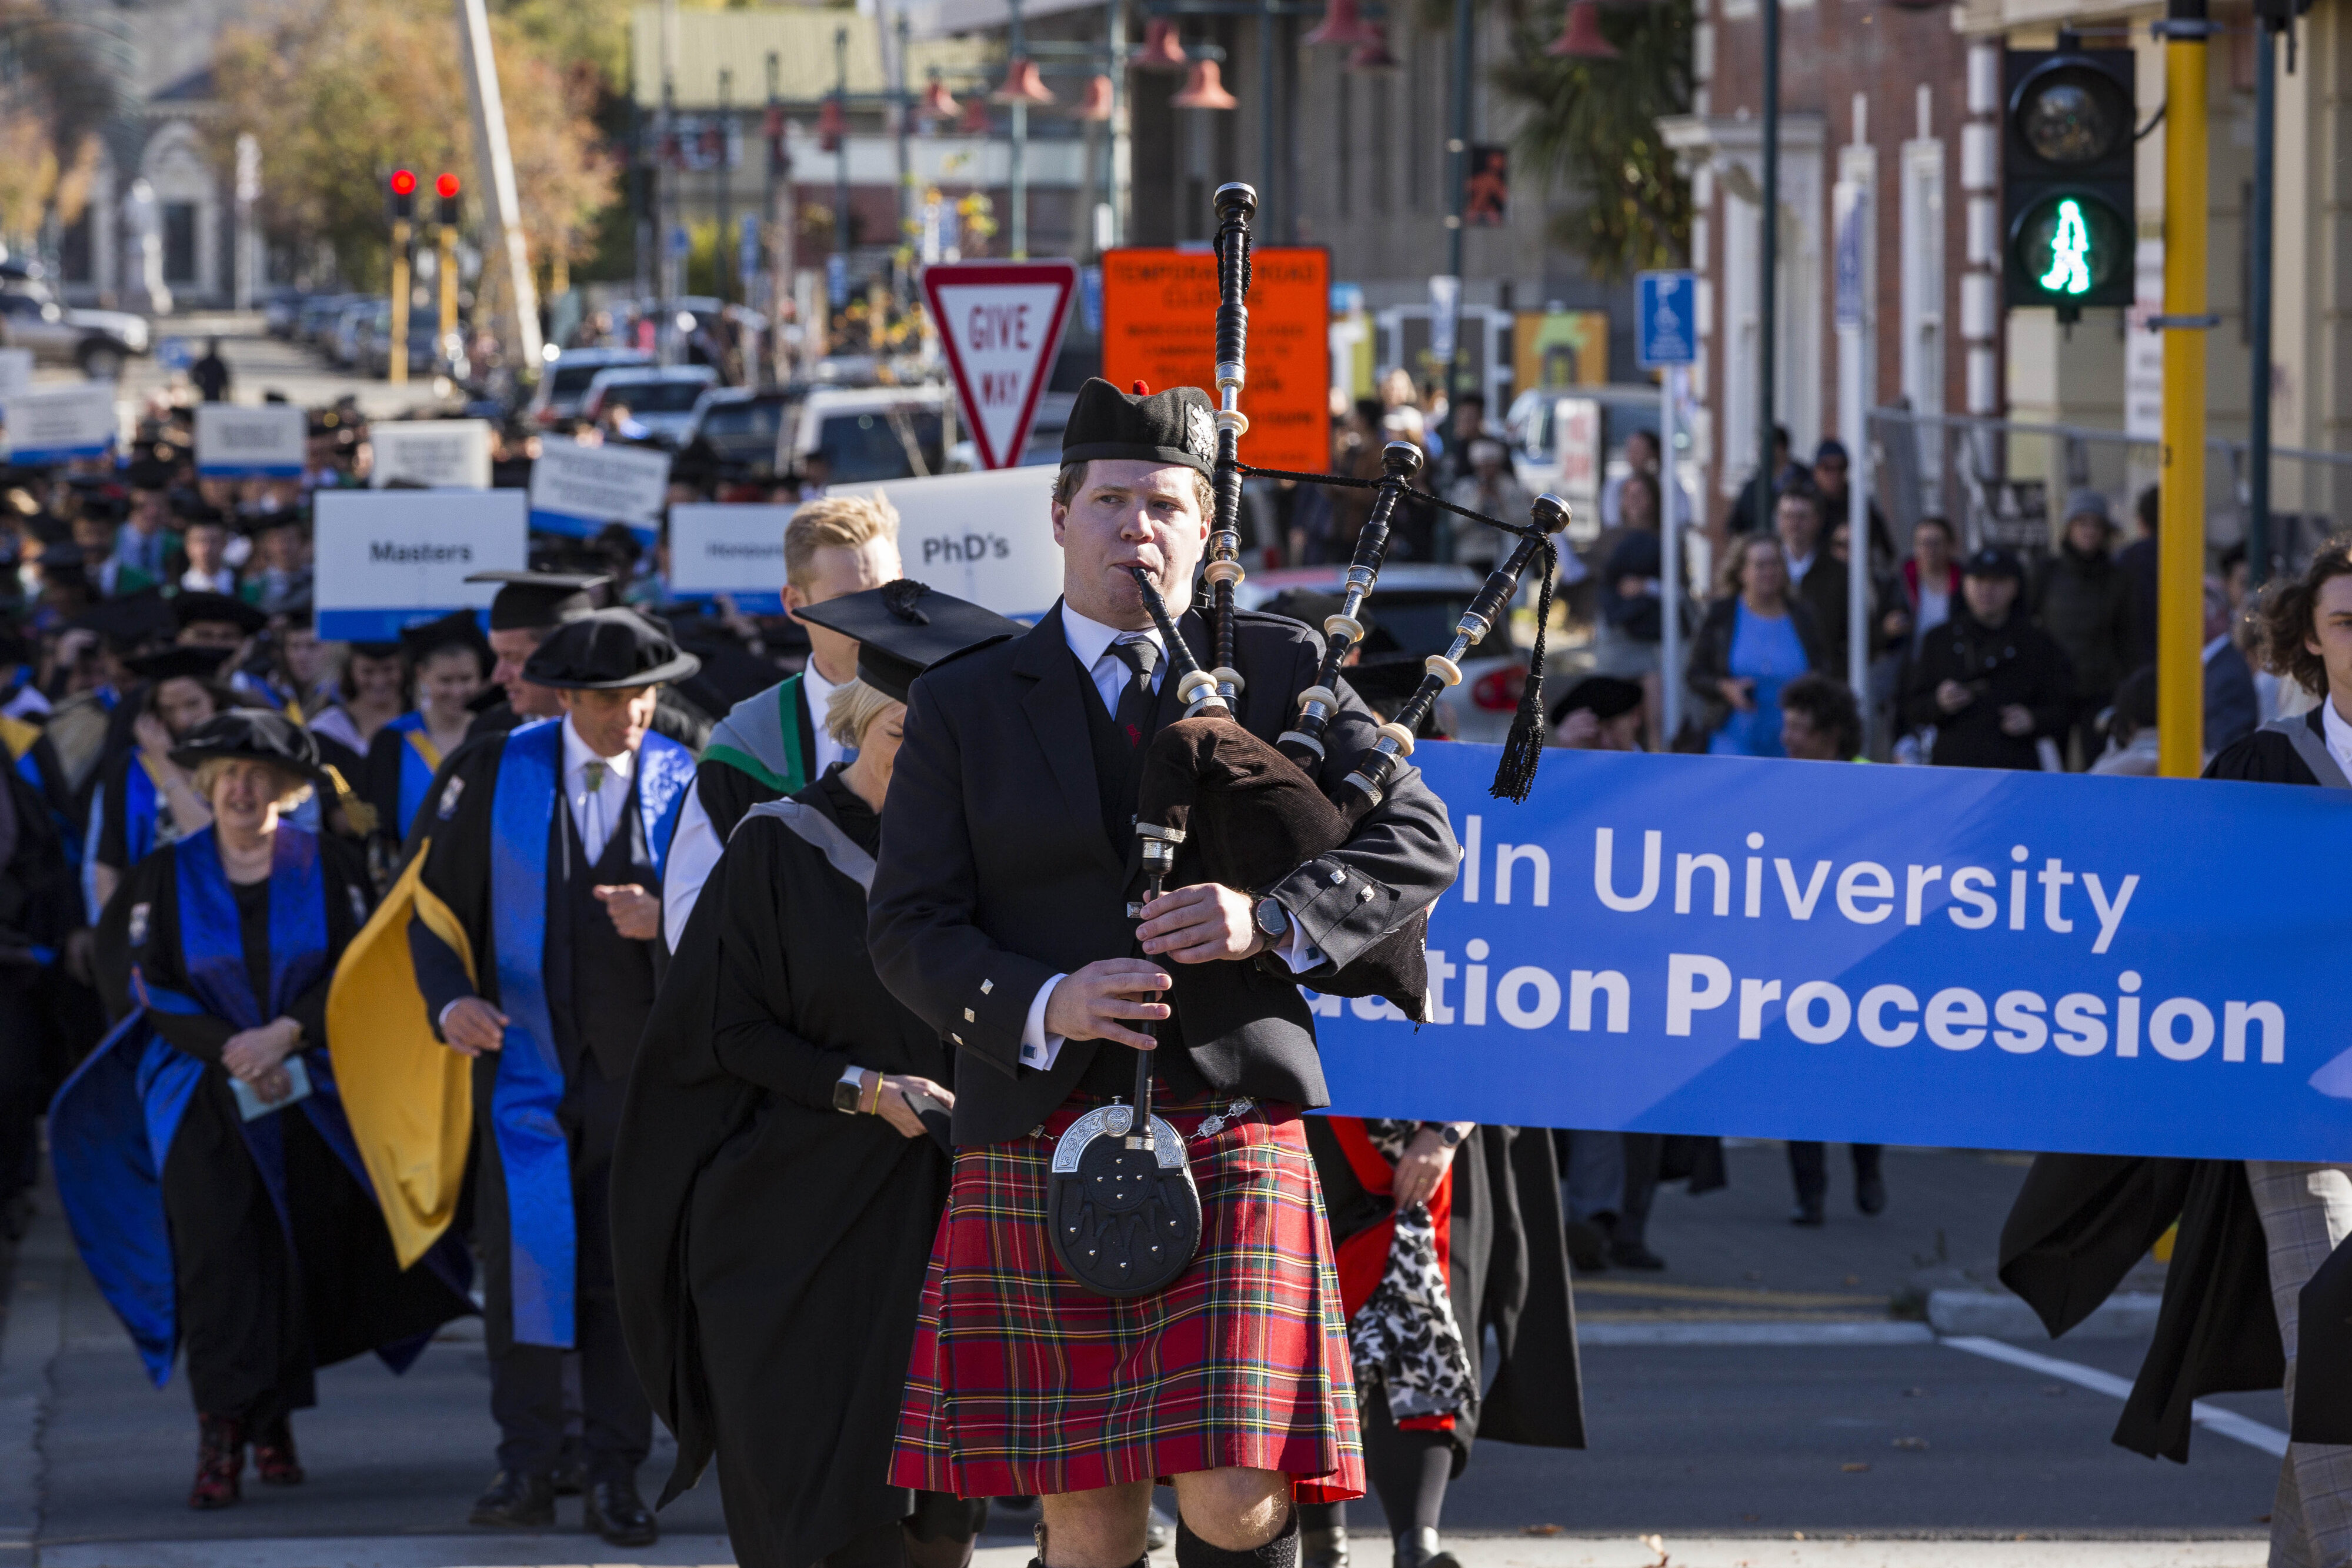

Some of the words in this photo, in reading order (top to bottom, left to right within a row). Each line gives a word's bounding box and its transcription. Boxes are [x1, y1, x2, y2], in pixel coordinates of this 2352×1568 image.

[969, 305, 1030, 351] GIVE
[982, 372, 1022, 406] WAY
[369, 540, 472, 563] Masters
[922, 532, 1010, 564] PhD's
[1463, 815, 1550, 907] ln
[1594, 828, 2139, 953] University
[1666, 953, 2284, 1063] Procession
